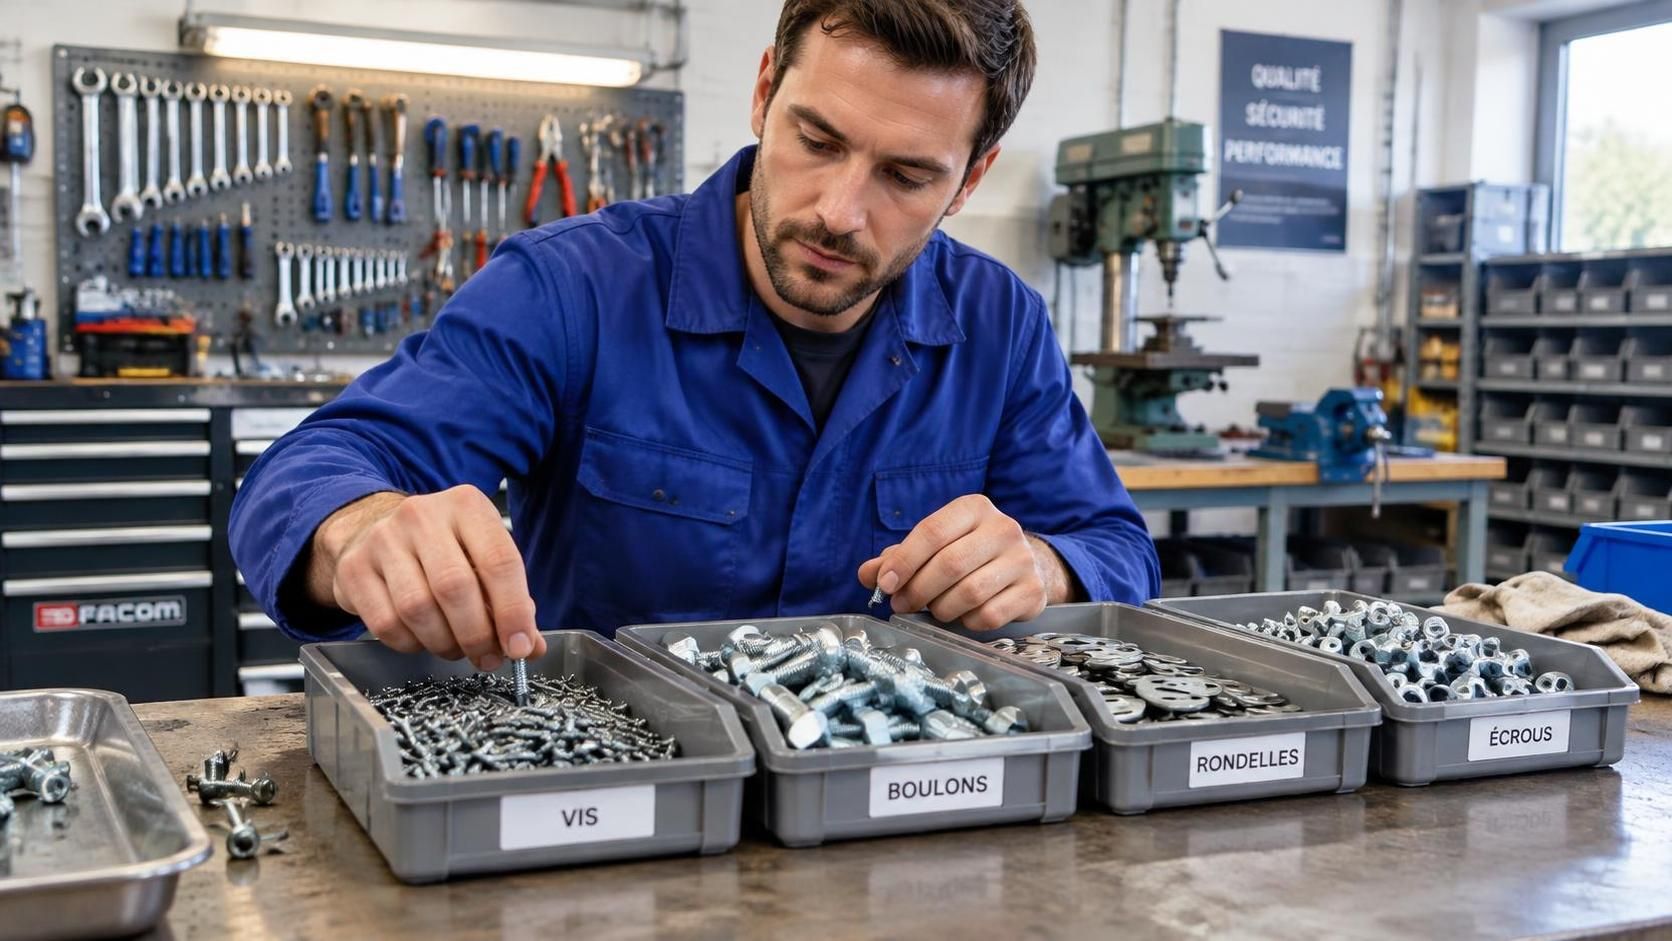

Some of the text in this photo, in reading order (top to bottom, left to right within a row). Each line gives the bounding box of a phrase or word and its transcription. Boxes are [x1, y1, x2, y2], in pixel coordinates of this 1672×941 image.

[1251, 63, 1321, 93] QUALITÉ
[1245, 99, 1325, 132] SÉCURITÉ
[1225, 138, 1343, 170] PERFORMANCE
[1489, 726, 1552, 746] ÉCROUS
[1197, 748, 1299, 773] RONDELLES
[888, 776, 988, 800] BOULONS
[561, 808, 599, 827] VIS
